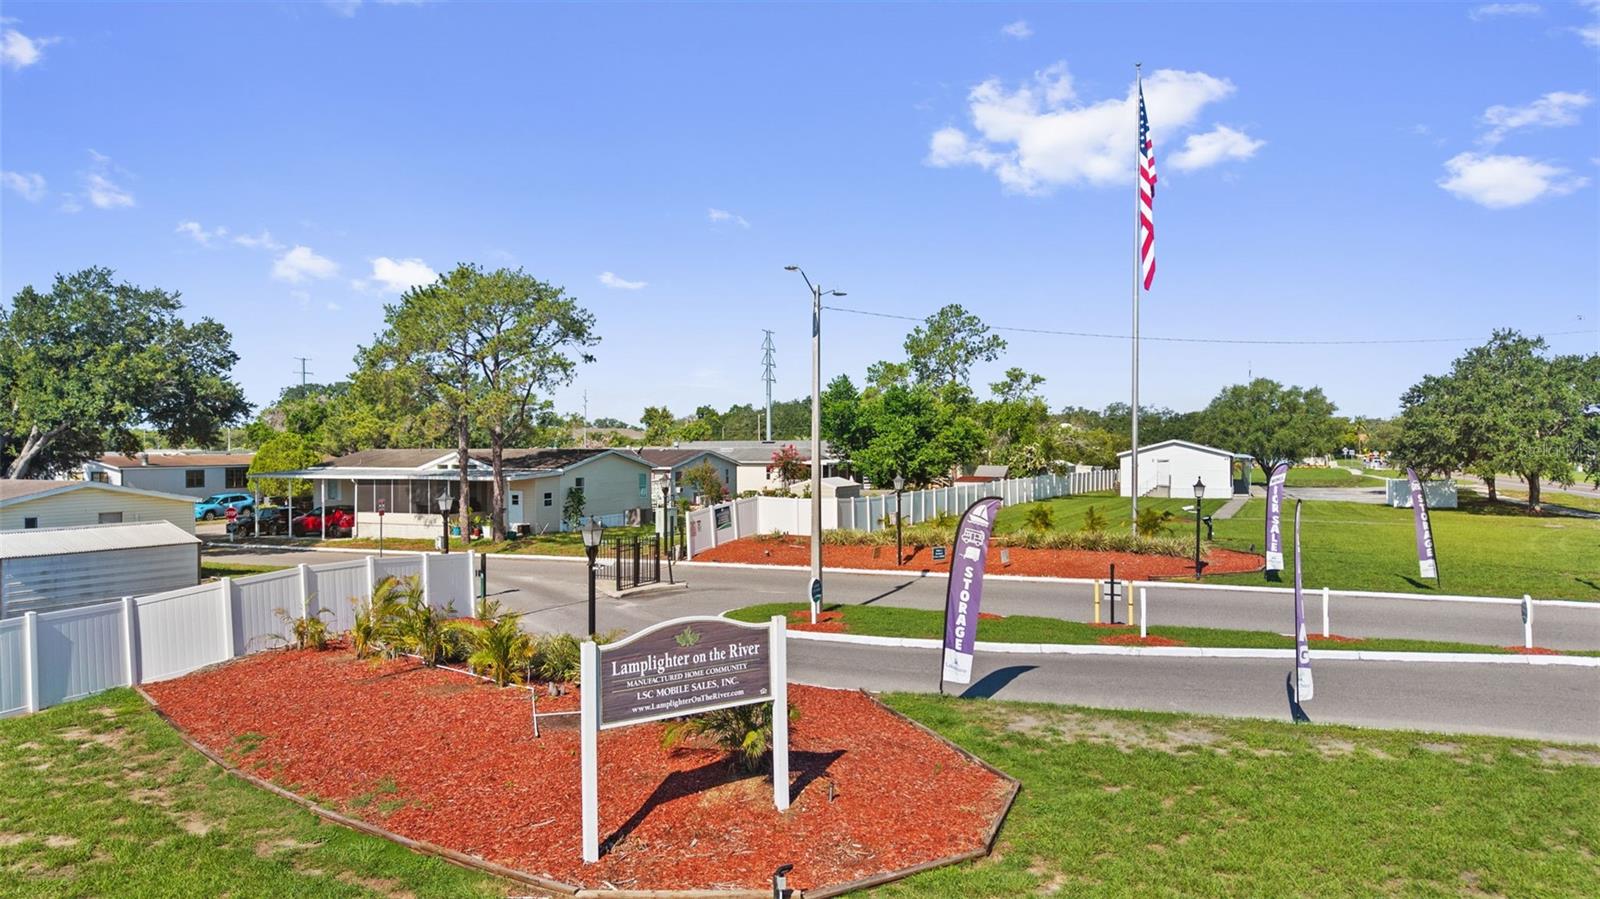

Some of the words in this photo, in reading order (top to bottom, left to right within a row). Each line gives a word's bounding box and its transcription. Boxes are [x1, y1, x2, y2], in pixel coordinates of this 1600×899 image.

[1271, 516, 1280, 552] SALE
[1417, 494, 1433, 557] STORAGE
[955, 566, 974, 651] STORAGE
[611, 652, 690, 677] Lamplighter
[692, 652, 707, 664] on
[709, 647, 726, 661] the
[729, 642, 760, 659] River
[626, 673, 684, 688] MANUFACTURED
[684, 669, 705, 679] HOME
[705, 663, 748, 675] COMMUNITY
[631, 690, 745, 712] www.LamplighterOnTheRiver.com
[637, 689, 654, 701] LSC
[656, 684, 690, 697] MOBILE
[691, 679, 720, 692] SALES,
[721, 676, 740, 688] INC.
